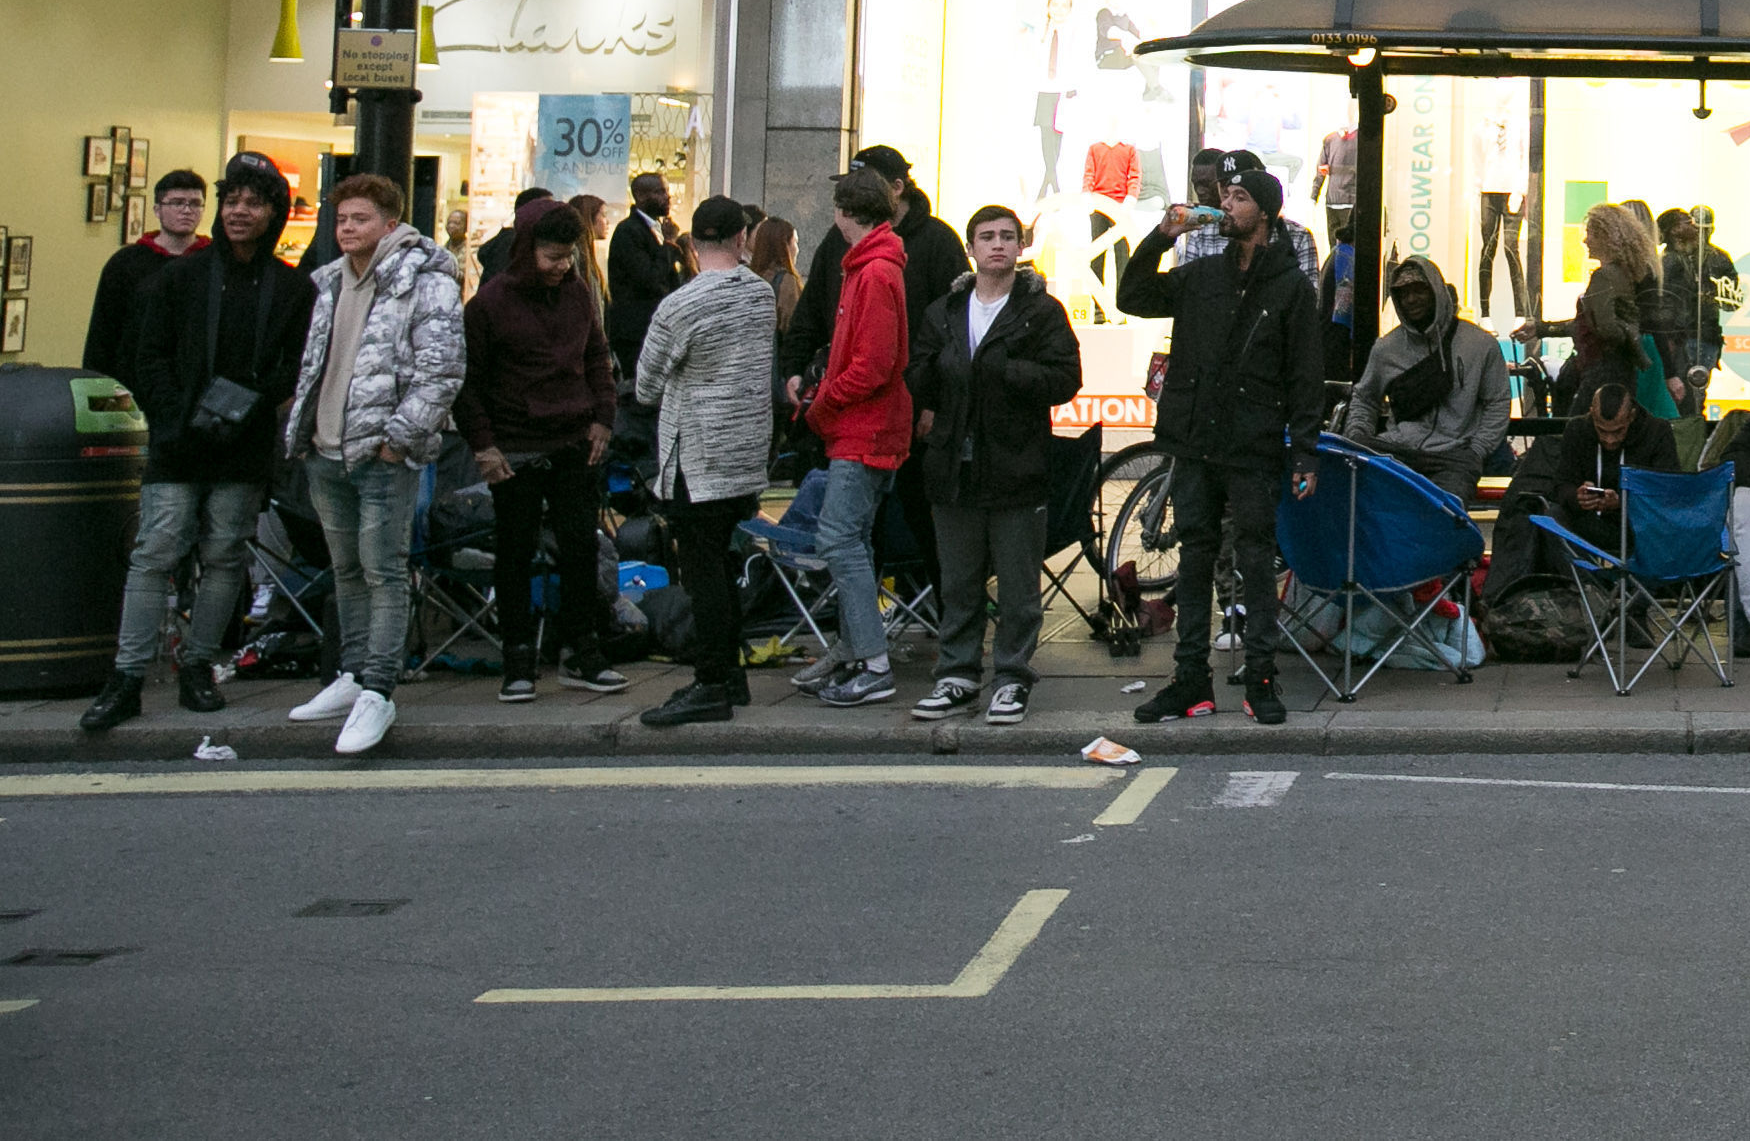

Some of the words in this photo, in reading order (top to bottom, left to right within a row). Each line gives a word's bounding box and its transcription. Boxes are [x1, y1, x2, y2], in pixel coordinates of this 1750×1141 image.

[1311, 33, 1342, 44] 0133
[1346, 33, 1378, 45] 0196
[342, 50, 358, 59] No
[361, 49, 409, 62] stopping
[356, 62, 393, 72] except
[343, 72, 370, 82] local
[374, 72, 405, 82] buses
[553, 117, 625, 158] 30%
[601, 146, 624, 158] OFF
[551, 160, 625, 176] SANDALS
[1409, 123, 1434, 260] OOLWEAR
[1051, 397, 1146, 423] ATION
